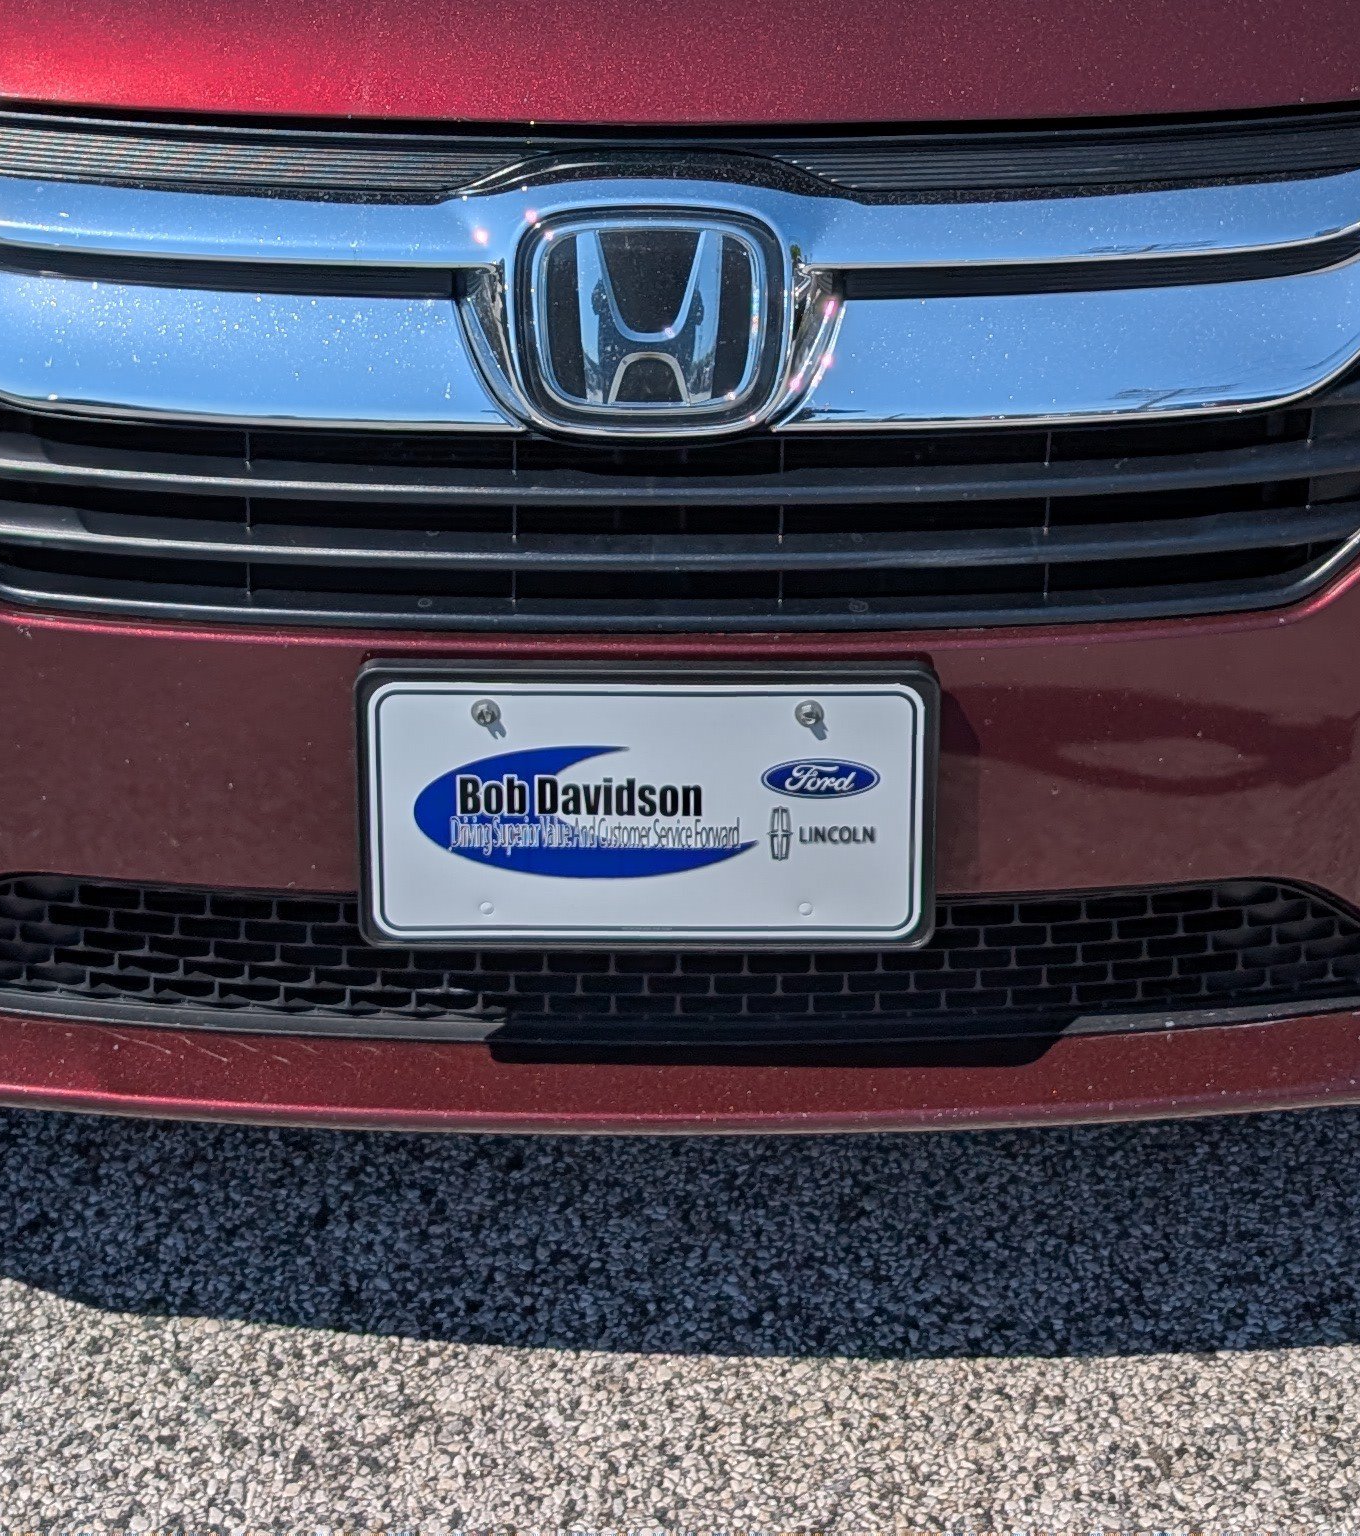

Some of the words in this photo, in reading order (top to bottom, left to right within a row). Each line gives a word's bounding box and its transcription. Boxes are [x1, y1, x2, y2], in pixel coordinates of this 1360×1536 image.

[784, 764, 857, 792] Ford
[457, 775, 528, 816] Bob
[536, 775, 703, 817] Davidson
[597, 817, 652, 848] Customer
[652, 818, 693, 848] Service
[693, 816, 741, 849] Forward
[798, 825, 876, 844] LINCOLN
